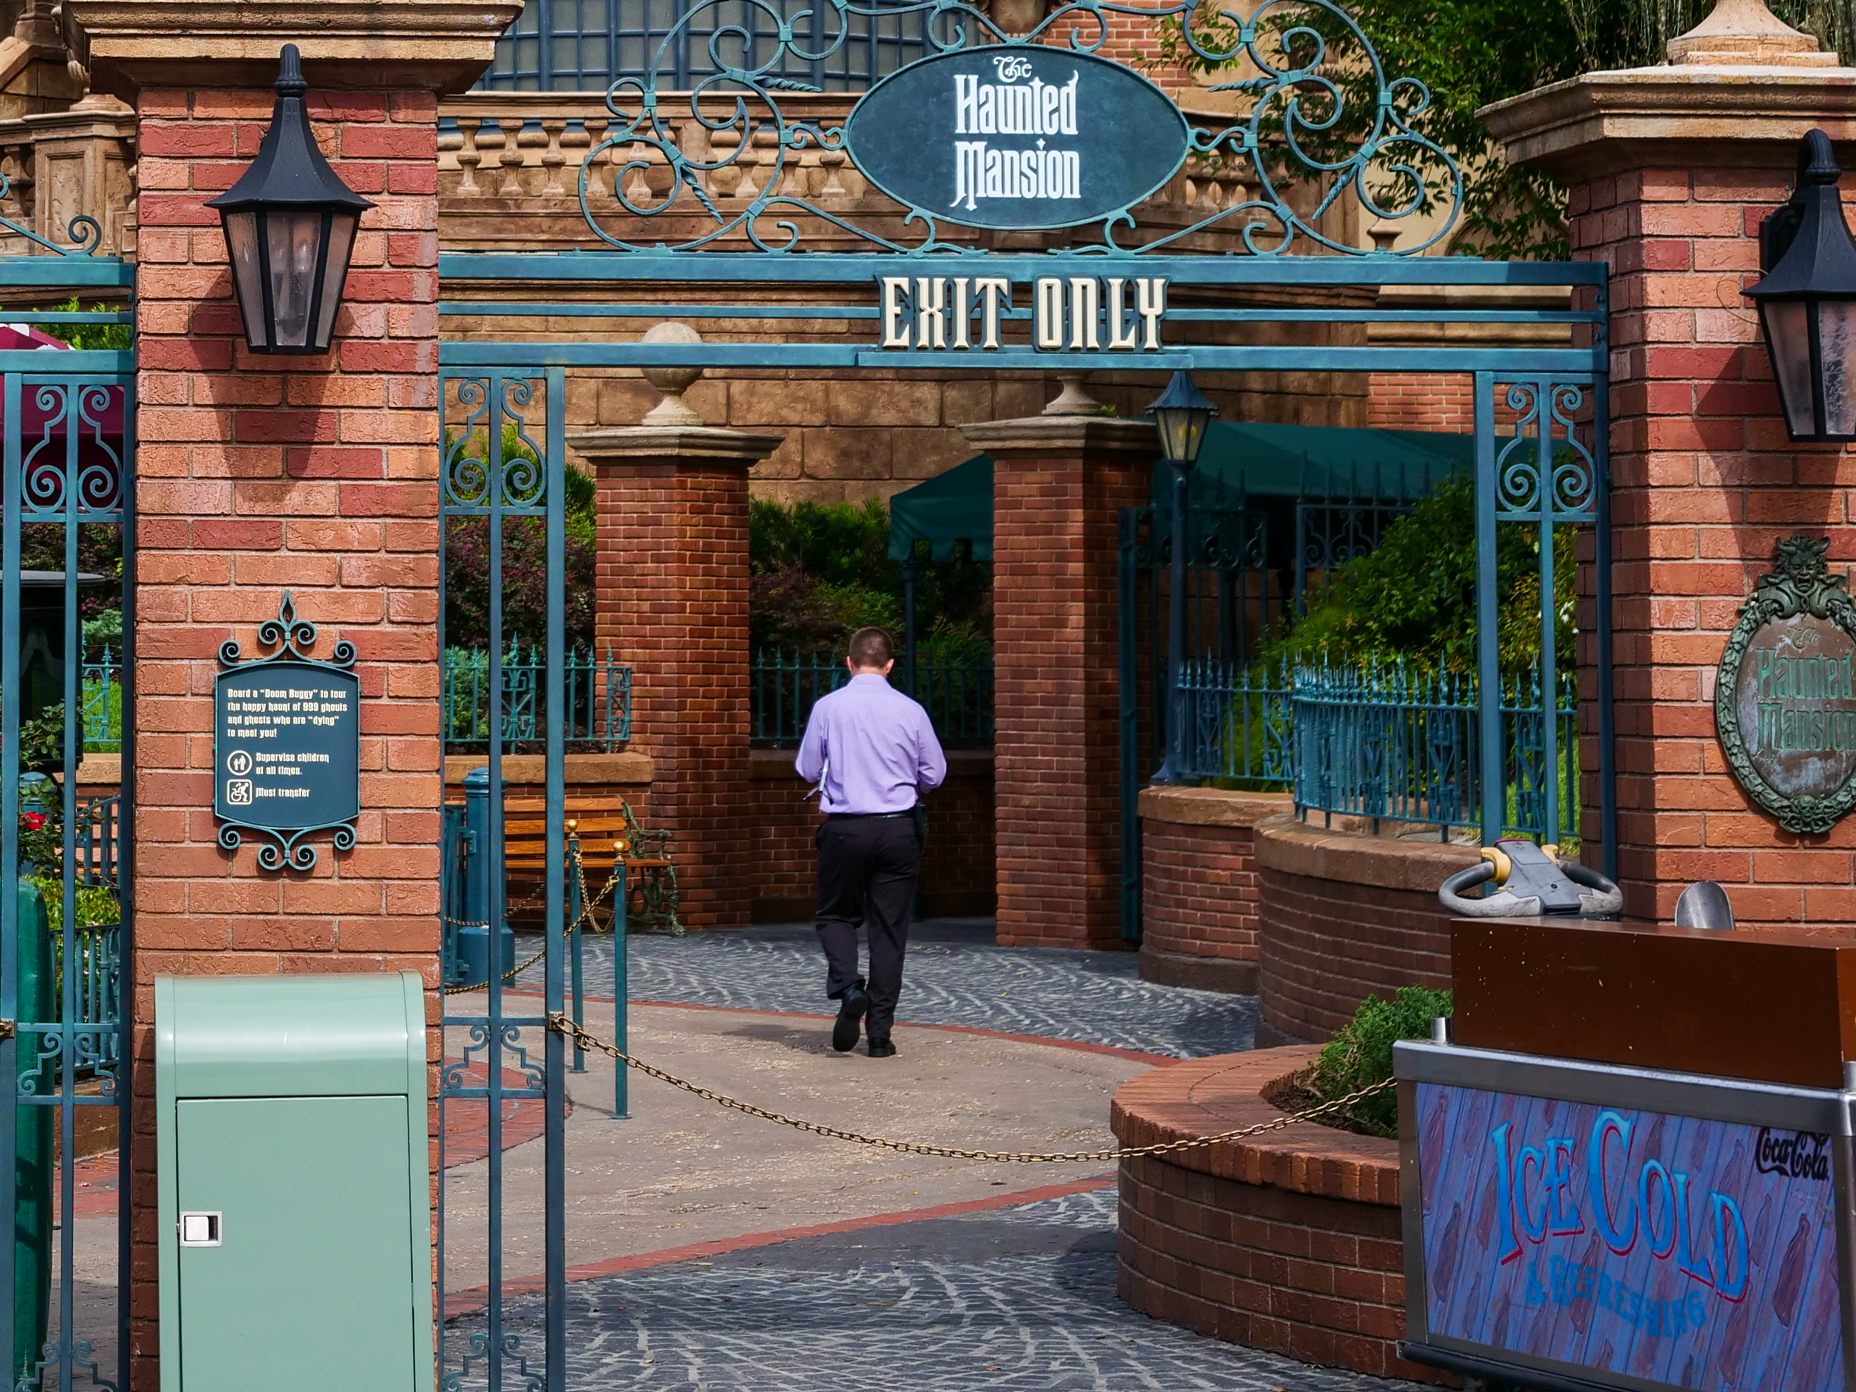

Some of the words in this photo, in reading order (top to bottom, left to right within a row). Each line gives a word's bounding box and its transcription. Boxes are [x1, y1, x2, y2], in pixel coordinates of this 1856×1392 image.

[993, 55, 1032, 82] The
[954, 70, 1080, 136] Haunted
[950, 138, 1082, 212] Mansion
[882, 276, 1012, 350] EXIT
[1038, 277, 1168, 351] ONLY
[1755, 647, 1854, 700] Haunted
[228, 688, 251, 698] Board
[252, 690, 258, 698] a
[320, 690, 328, 698] to
[330, 690, 346, 698] tour
[228, 702, 240, 712] the
[242, 702, 266, 712] happy
[268, 702, 290, 712] haunt
[292, 702, 301, 711] of
[302, 702, 319, 711] 999
[321, 702, 347, 713] ghouls
[228, 715, 242, 725] and
[244, 715, 271, 725] ghosts
[273, 715, 291, 725] who
[227, 729, 236, 737] to
[237, 729, 257, 738] meet
[259, 728, 277, 738] you!
[256, 752, 295, 763] Supervise
[297, 753, 329, 763] children
[256, 766, 264, 775] at
[266, 766, 276, 775] all
[278, 766, 302, 776] times.
[256, 787, 276, 798] Must
[278, 788, 310, 798] transfer
[1755, 1126, 1830, 1182] Coca-Cola
[1491, 1120, 1584, 1265] ICE
[1588, 1109, 1752, 1304] COLD
[1549, 1255, 1708, 1340] REFRESHING
